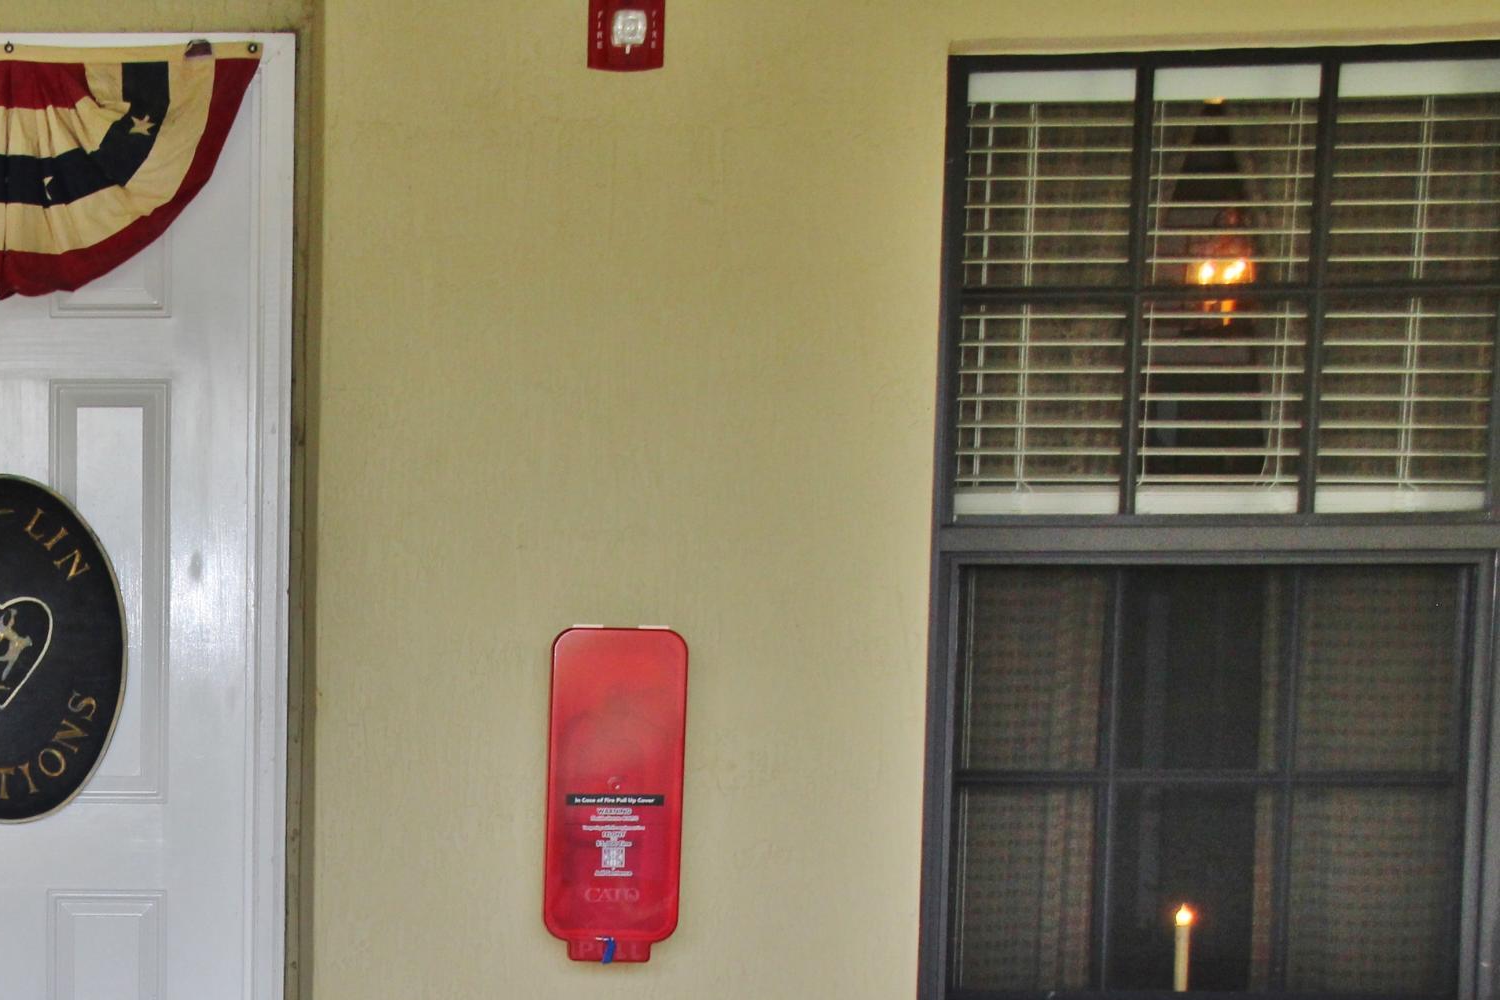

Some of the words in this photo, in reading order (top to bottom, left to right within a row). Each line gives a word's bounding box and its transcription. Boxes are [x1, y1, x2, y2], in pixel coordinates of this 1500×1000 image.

[574, 796, 581, 804] In
[581, 796, 596, 804] Case
[596, 796, 603, 804] of
[604, 796, 615, 804] Fire
[616, 796, 627, 804] Pull
[628, 797, 637, 805] Up
[637, 796, 655, 804] Cover
